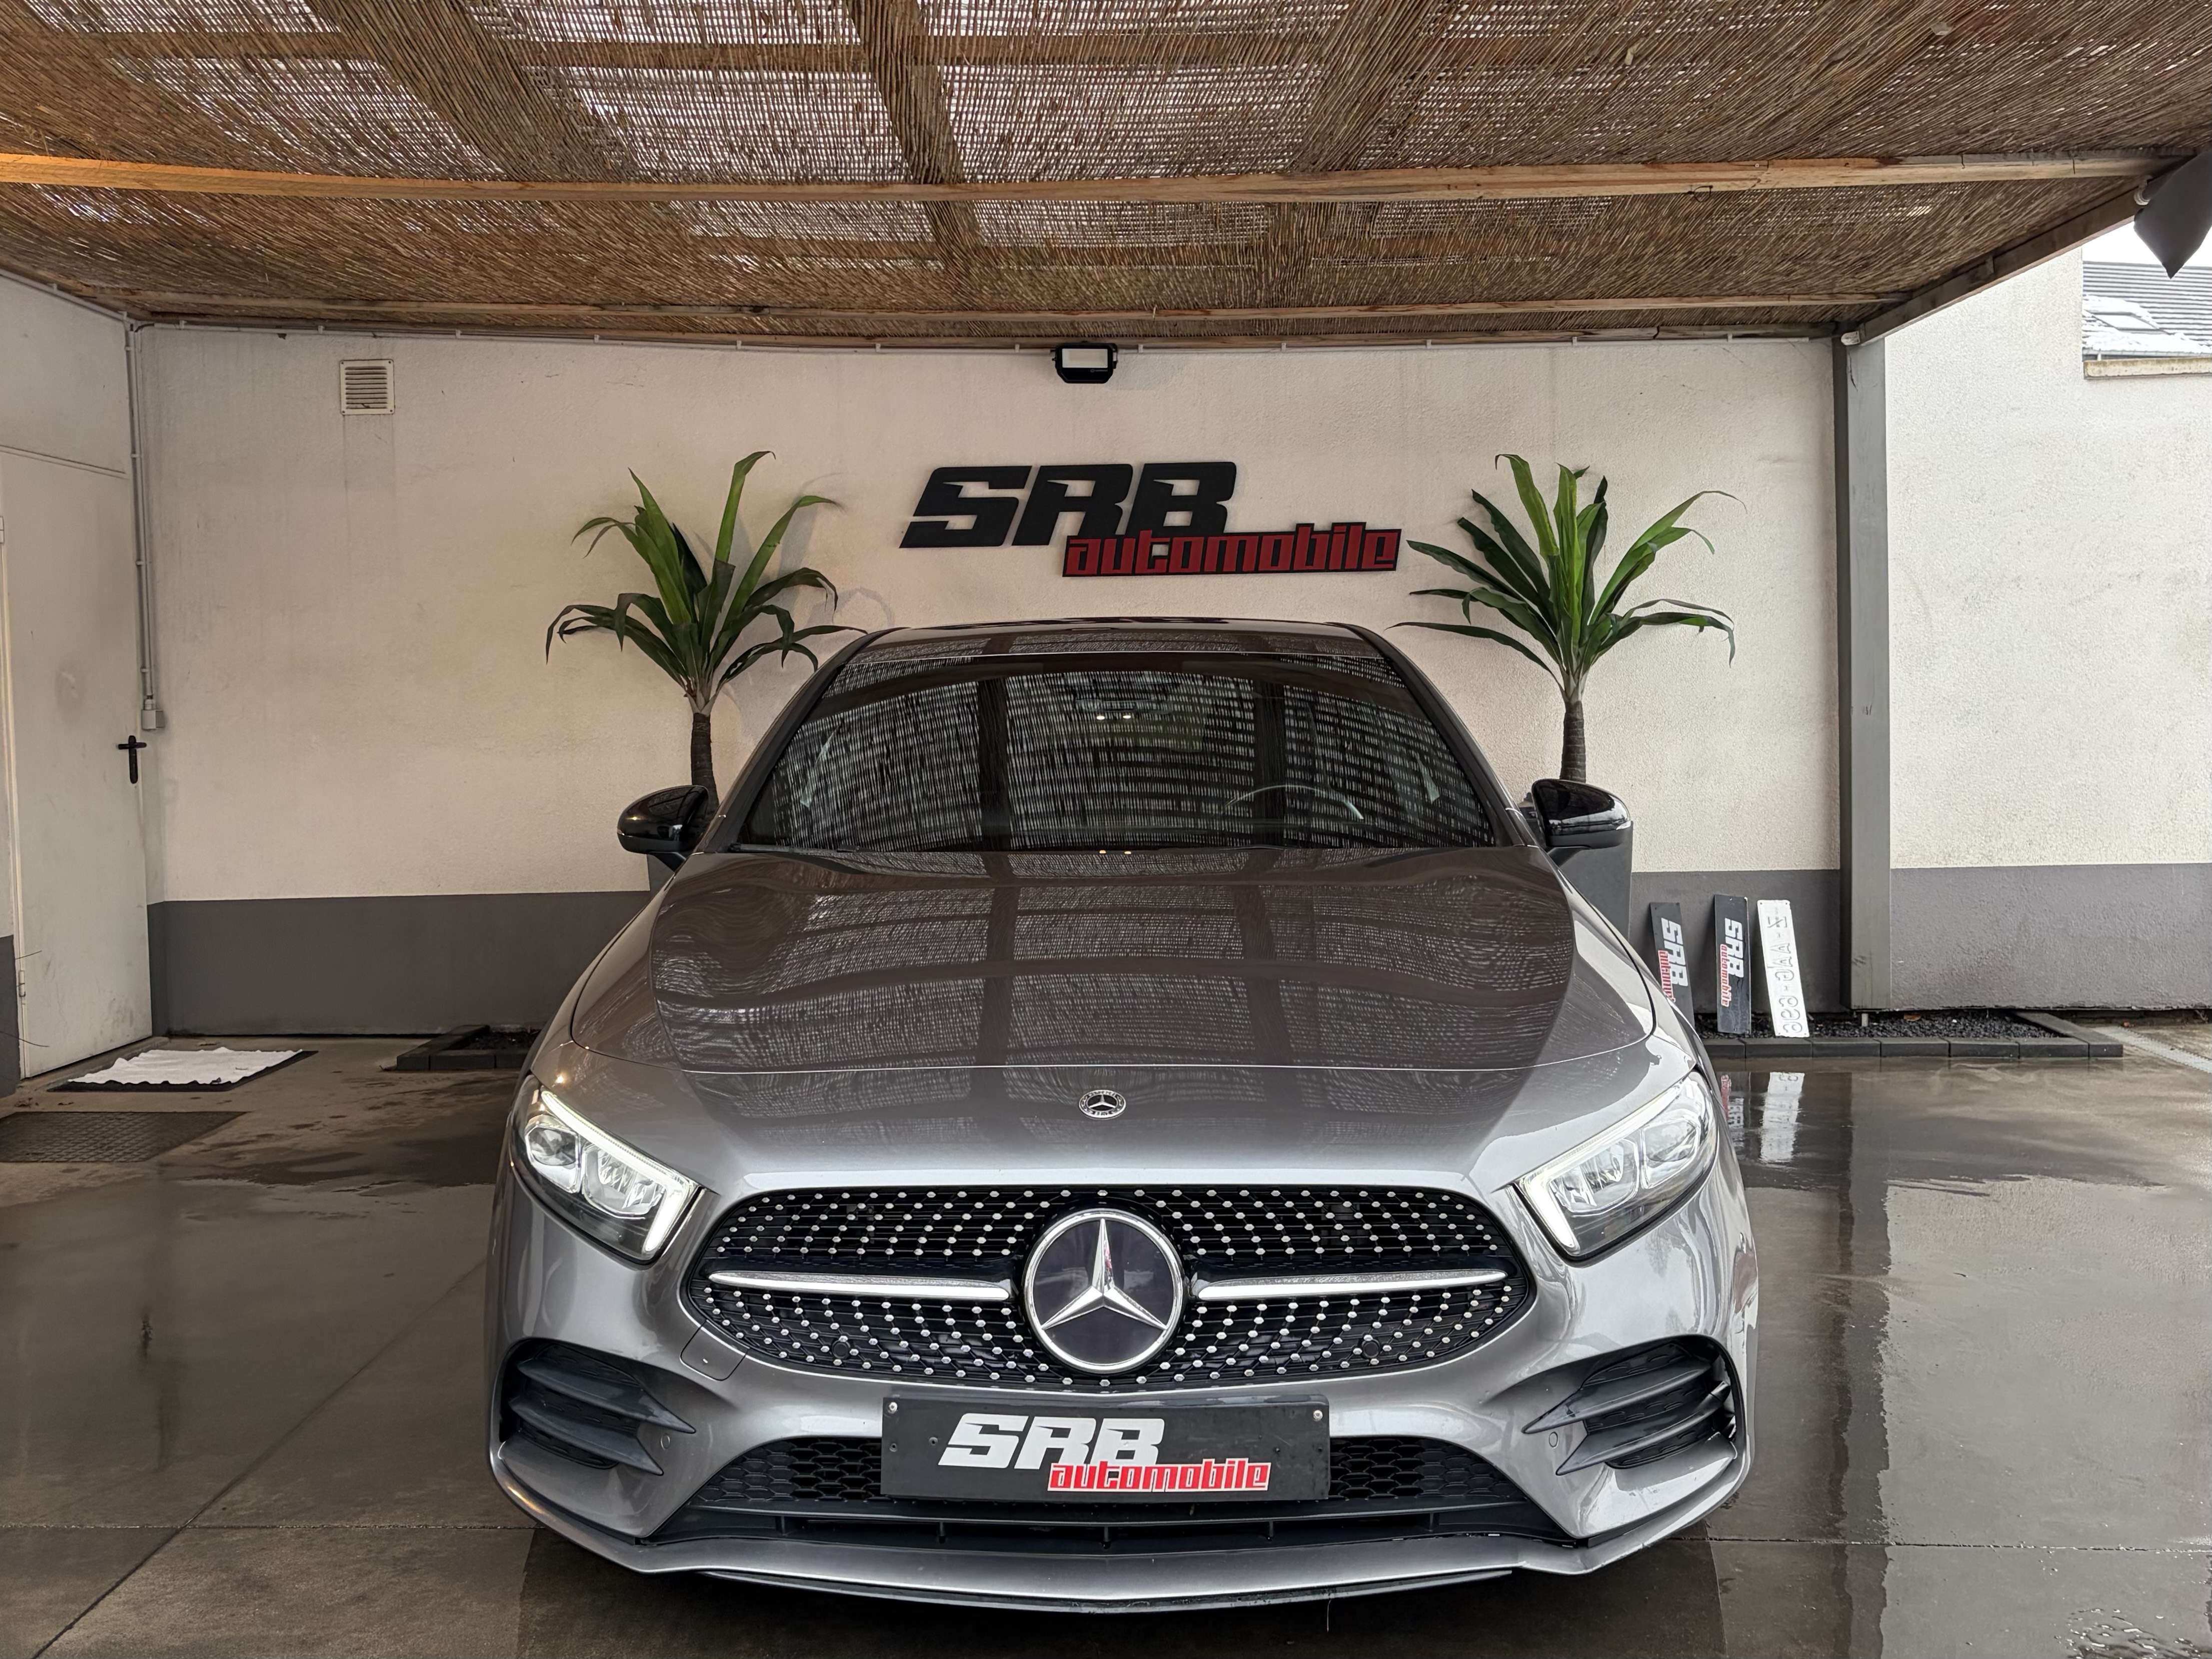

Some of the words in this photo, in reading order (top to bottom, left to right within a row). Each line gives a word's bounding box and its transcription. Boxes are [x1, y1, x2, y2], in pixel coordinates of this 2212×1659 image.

[900, 462, 1237, 548] SRB
[1063, 522, 1400, 576] automobile
[1661, 917, 1688, 987] SRB
[1720, 944, 1732, 1007] automobile
[1725, 917, 1744, 978] SRB
[938, 1413, 1165, 1469] SRB
[1048, 1458, 1272, 1492] automobile
